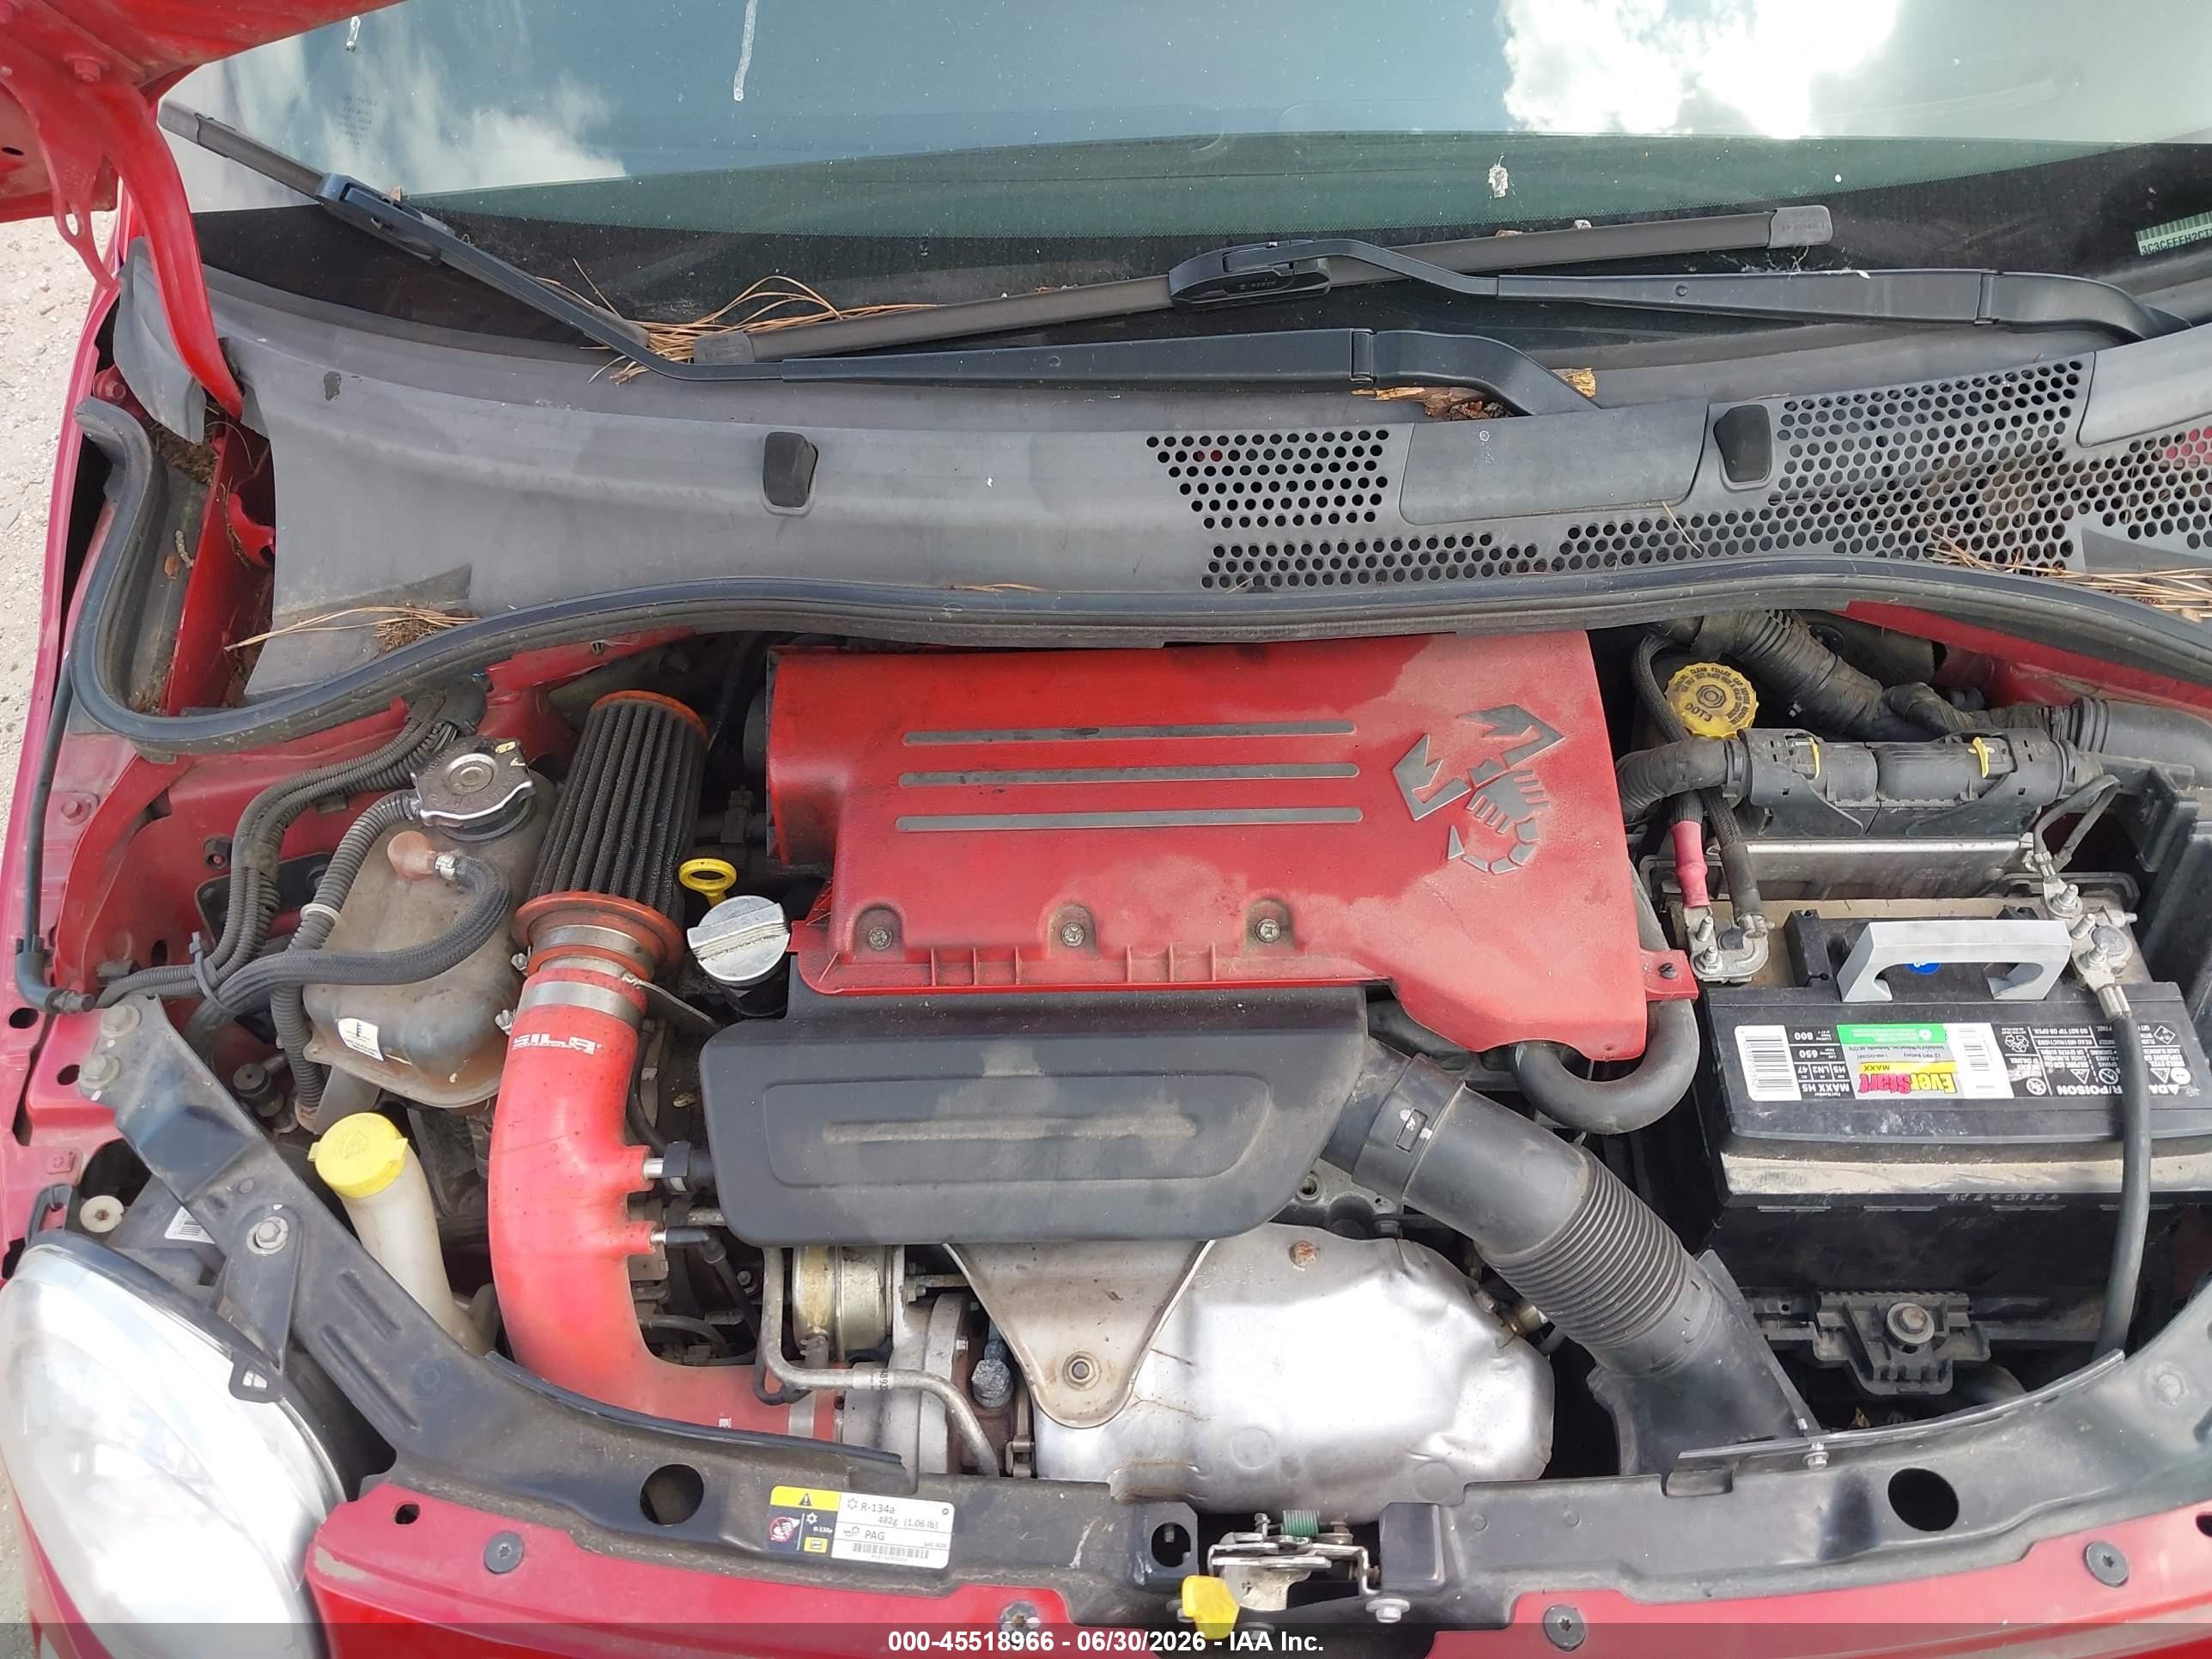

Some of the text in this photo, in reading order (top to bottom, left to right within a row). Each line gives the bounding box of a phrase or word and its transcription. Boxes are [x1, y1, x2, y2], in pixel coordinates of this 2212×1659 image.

[1684, 702, 1713, 722] DOT3
[1794, 1032, 1814, 1041] 800
[1799, 1049, 1818, 1059] 650
[1802, 1084, 1850, 1092] MAXX H5
[1859, 1073, 1958, 1094] EverStart
[860, 1503, 896, 1514] R-134a
[878, 1516, 939, 1529] 482g (1.06 lb)
[865, 1530, 885, 1540] PAG
